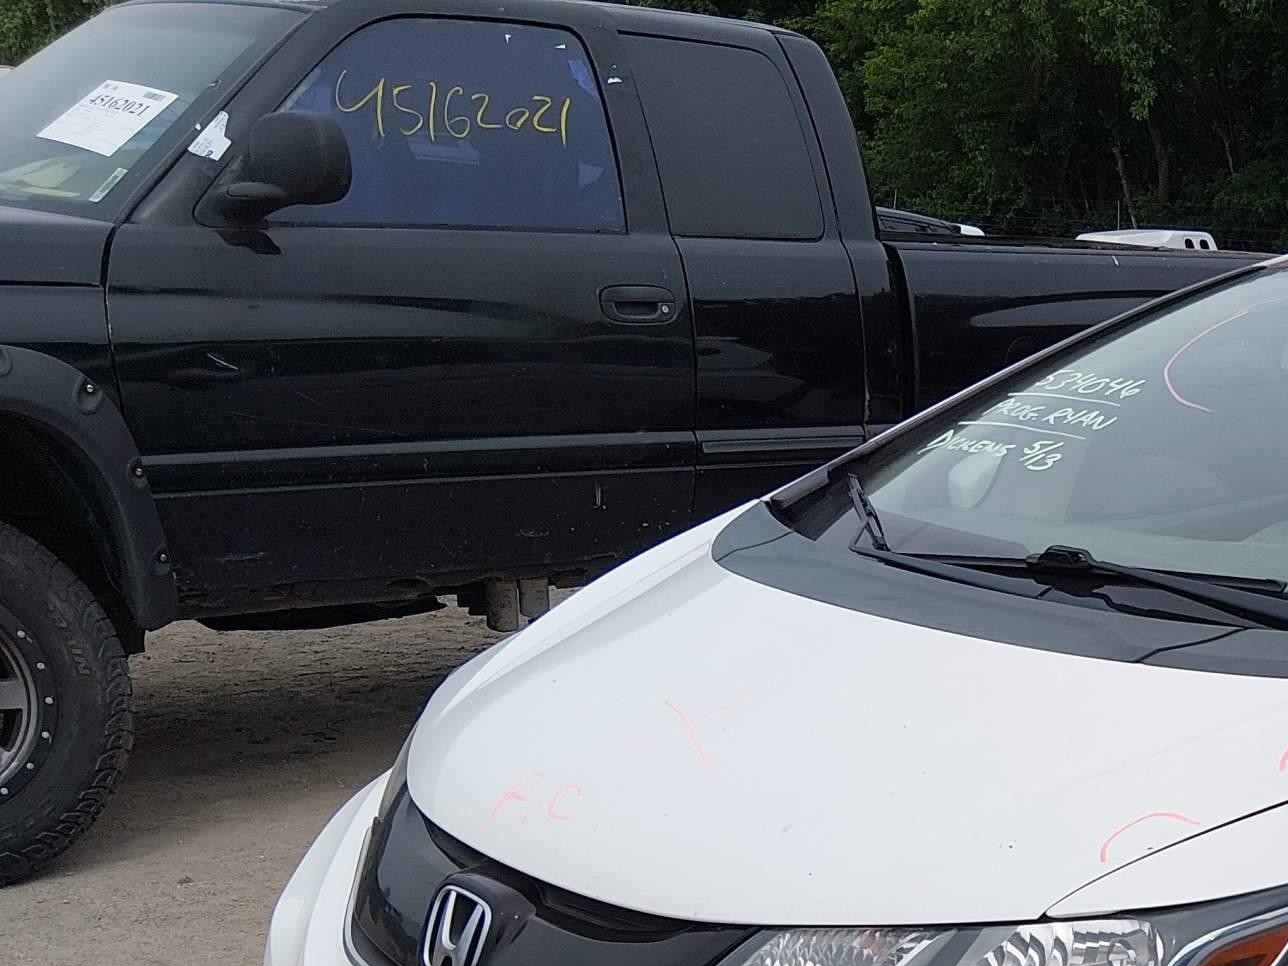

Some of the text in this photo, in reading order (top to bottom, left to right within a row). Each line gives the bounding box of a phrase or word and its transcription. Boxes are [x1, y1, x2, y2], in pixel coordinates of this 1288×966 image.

[90, 94, 152, 117] 45162021
[335, 69, 570, 148] 45162021
[1043, 407, 1117, 431] RYAN
[917, 429, 1065, 471] DICKENS 5/13
